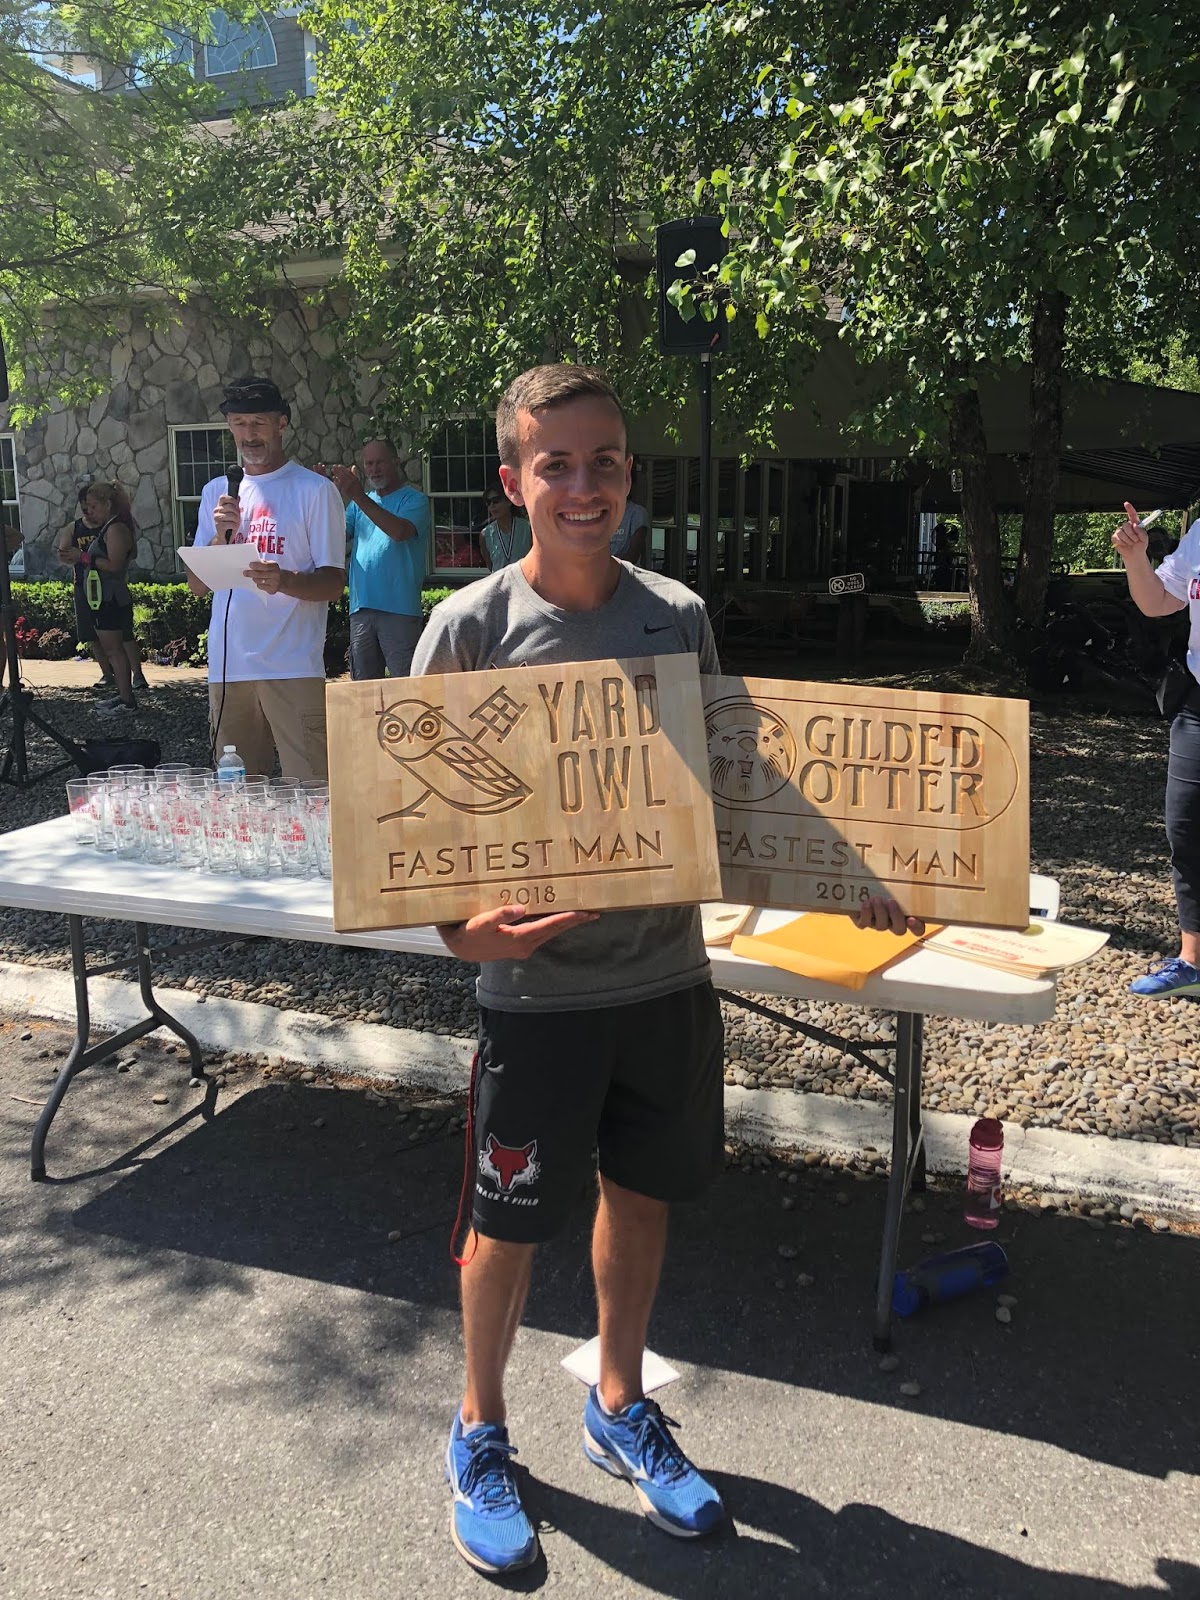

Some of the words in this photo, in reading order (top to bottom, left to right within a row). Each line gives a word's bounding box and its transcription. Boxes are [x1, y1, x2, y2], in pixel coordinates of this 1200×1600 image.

[249, 519, 276, 533] paltz
[537, 674, 661, 743] YARD
[804, 715, 985, 770] GILDED
[557, 745, 667, 815] OWL
[800, 759, 990, 819] OTTER
[388, 840, 554, 881] FASTEST
[572, 830, 664, 865] MAN
[716, 830, 873, 869] FASTEST
[891, 845, 978, 880] MAN
[500, 885, 556, 906] 2018
[816, 882, 870, 902] 2018
